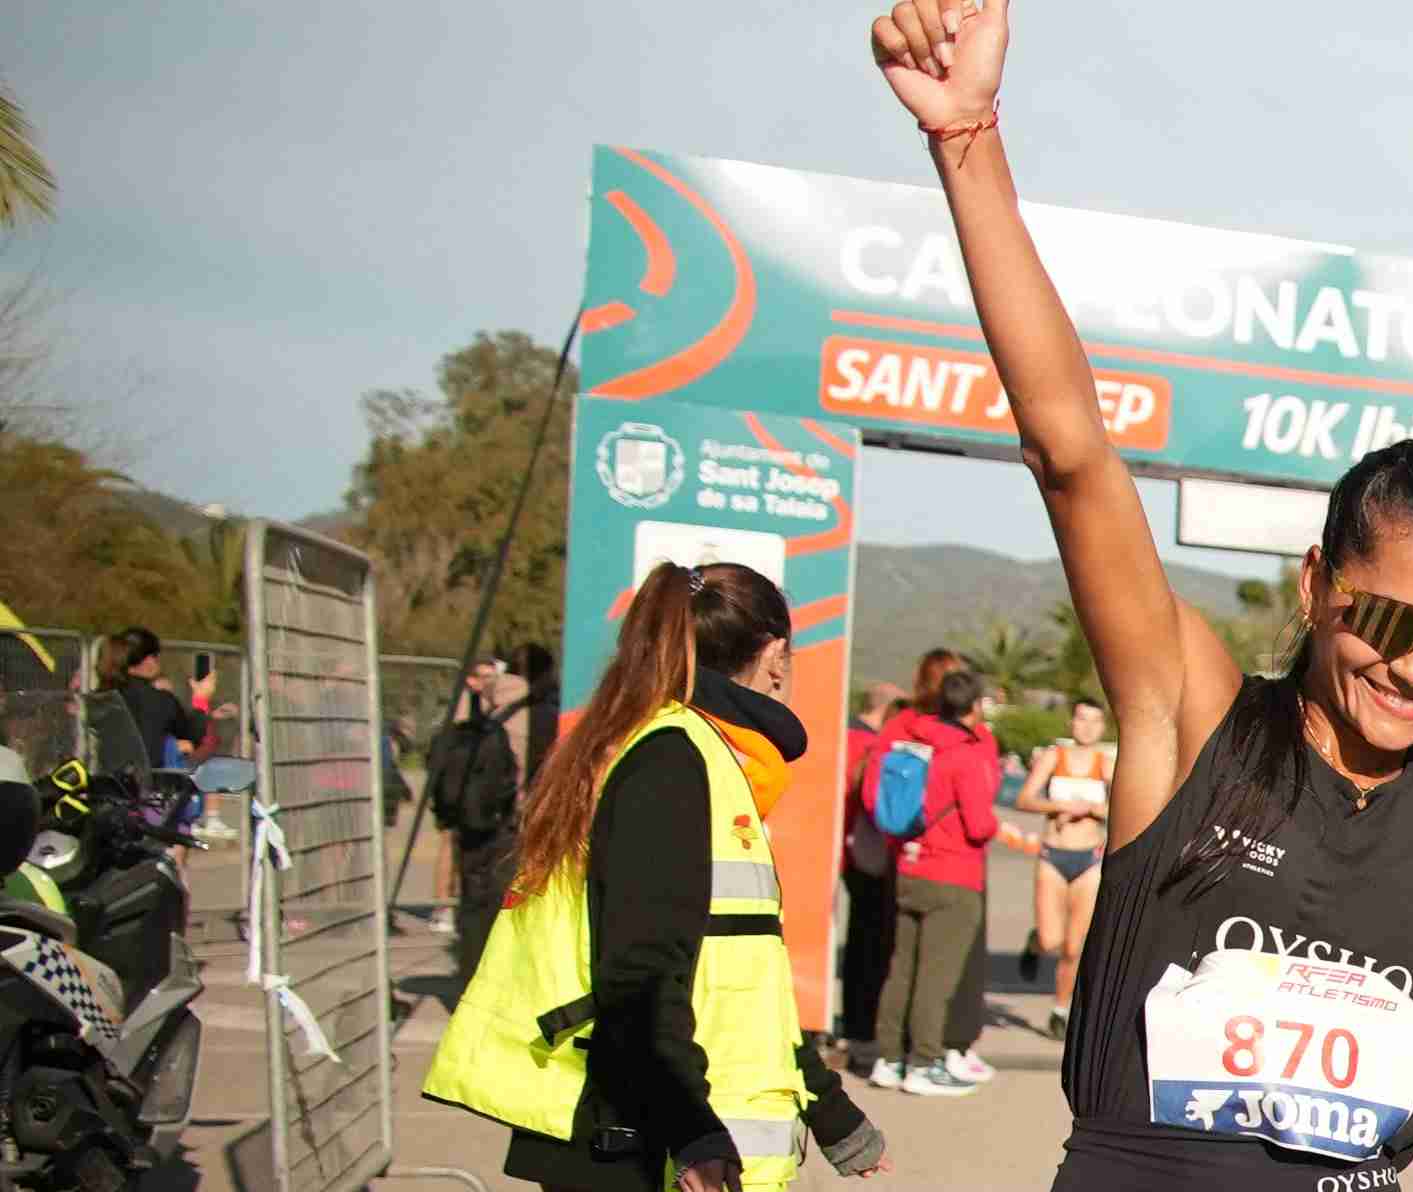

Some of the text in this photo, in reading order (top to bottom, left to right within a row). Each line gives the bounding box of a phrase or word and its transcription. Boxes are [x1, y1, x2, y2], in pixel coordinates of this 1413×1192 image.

[828, 349, 987, 416] SANT
[1241, 392, 1342, 461] 10K
[698, 459, 840, 502] Sant Josep
[1242, 836, 1286, 860] VICKY
[1247, 850, 1279, 867] OODS
[1222, 1014, 1360, 1090] 870
